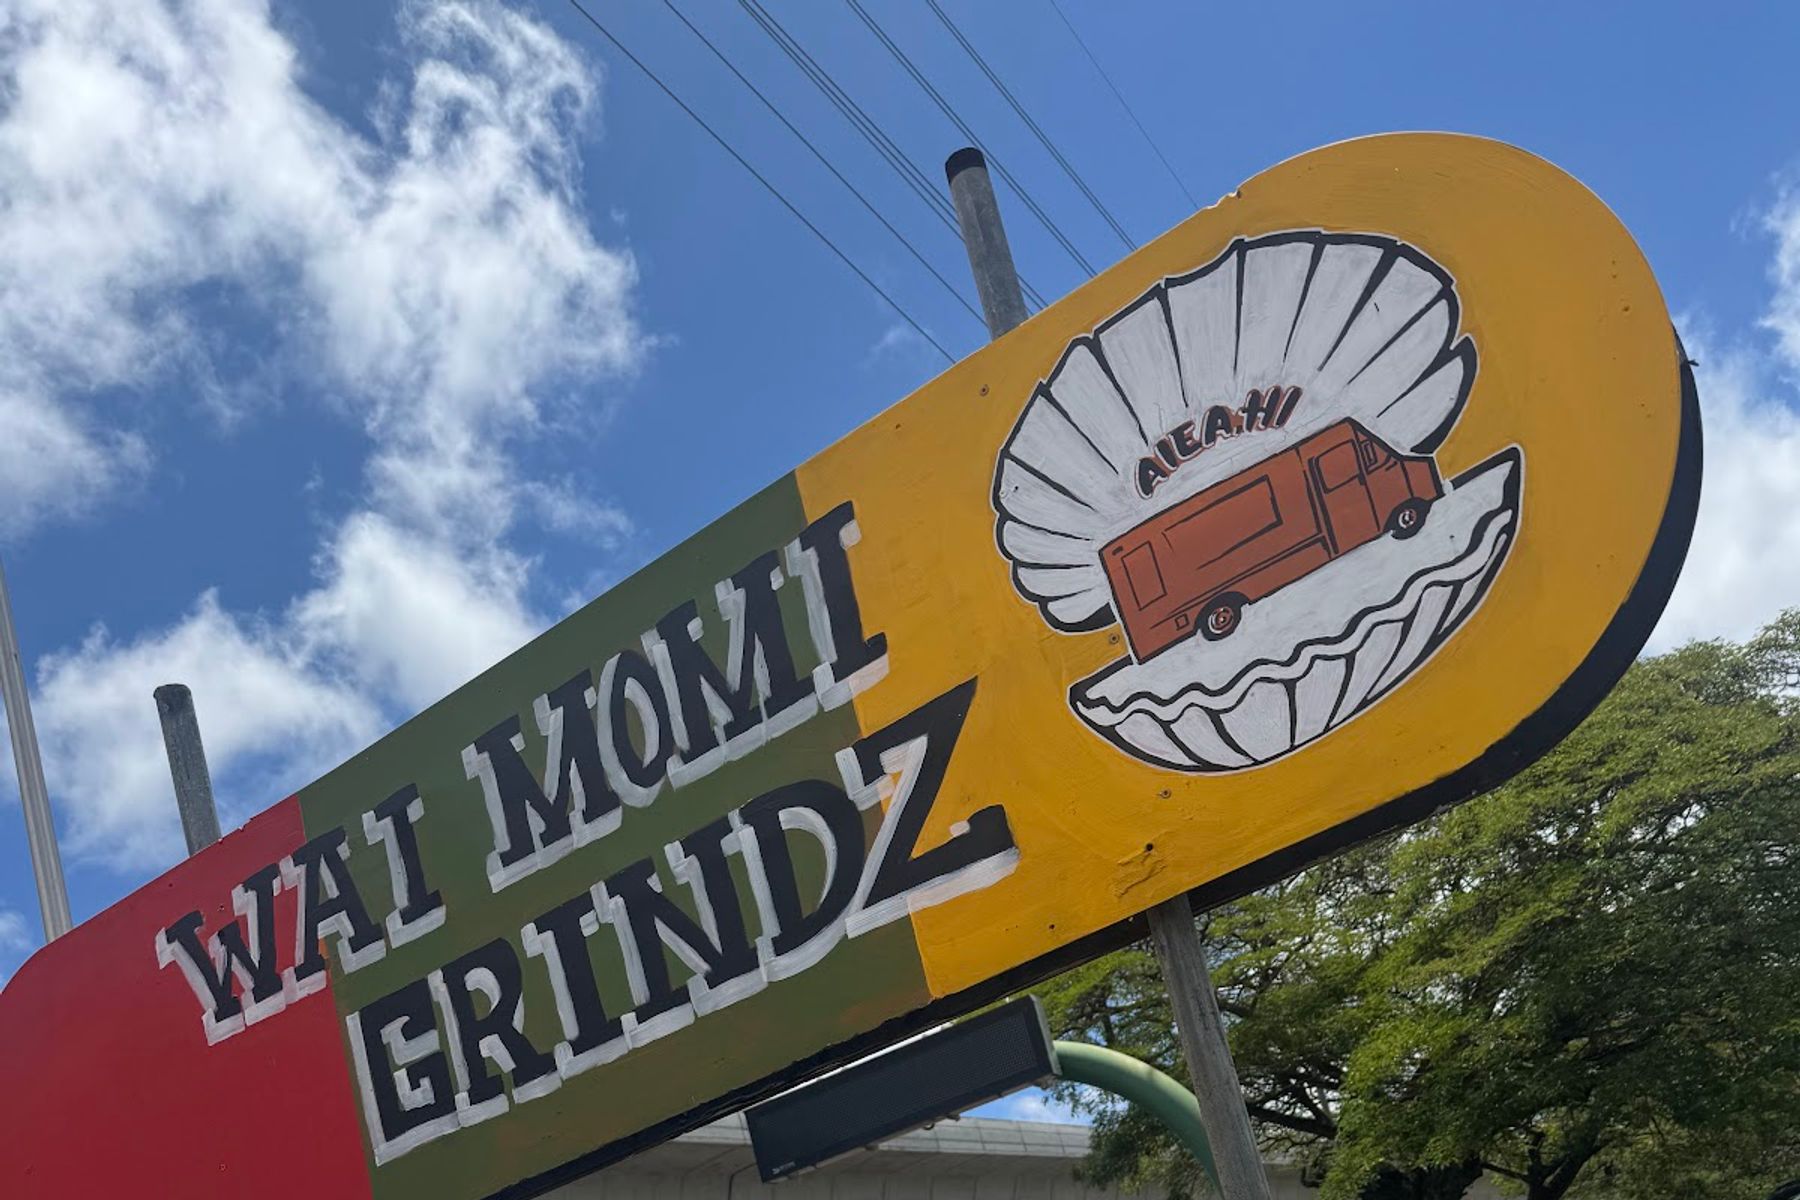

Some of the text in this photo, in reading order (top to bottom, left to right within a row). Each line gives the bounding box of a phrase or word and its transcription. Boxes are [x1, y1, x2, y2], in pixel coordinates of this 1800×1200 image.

[156, 500, 889, 1045] WAI MOMI
[345, 677, 1020, 1165] GRINDZ
